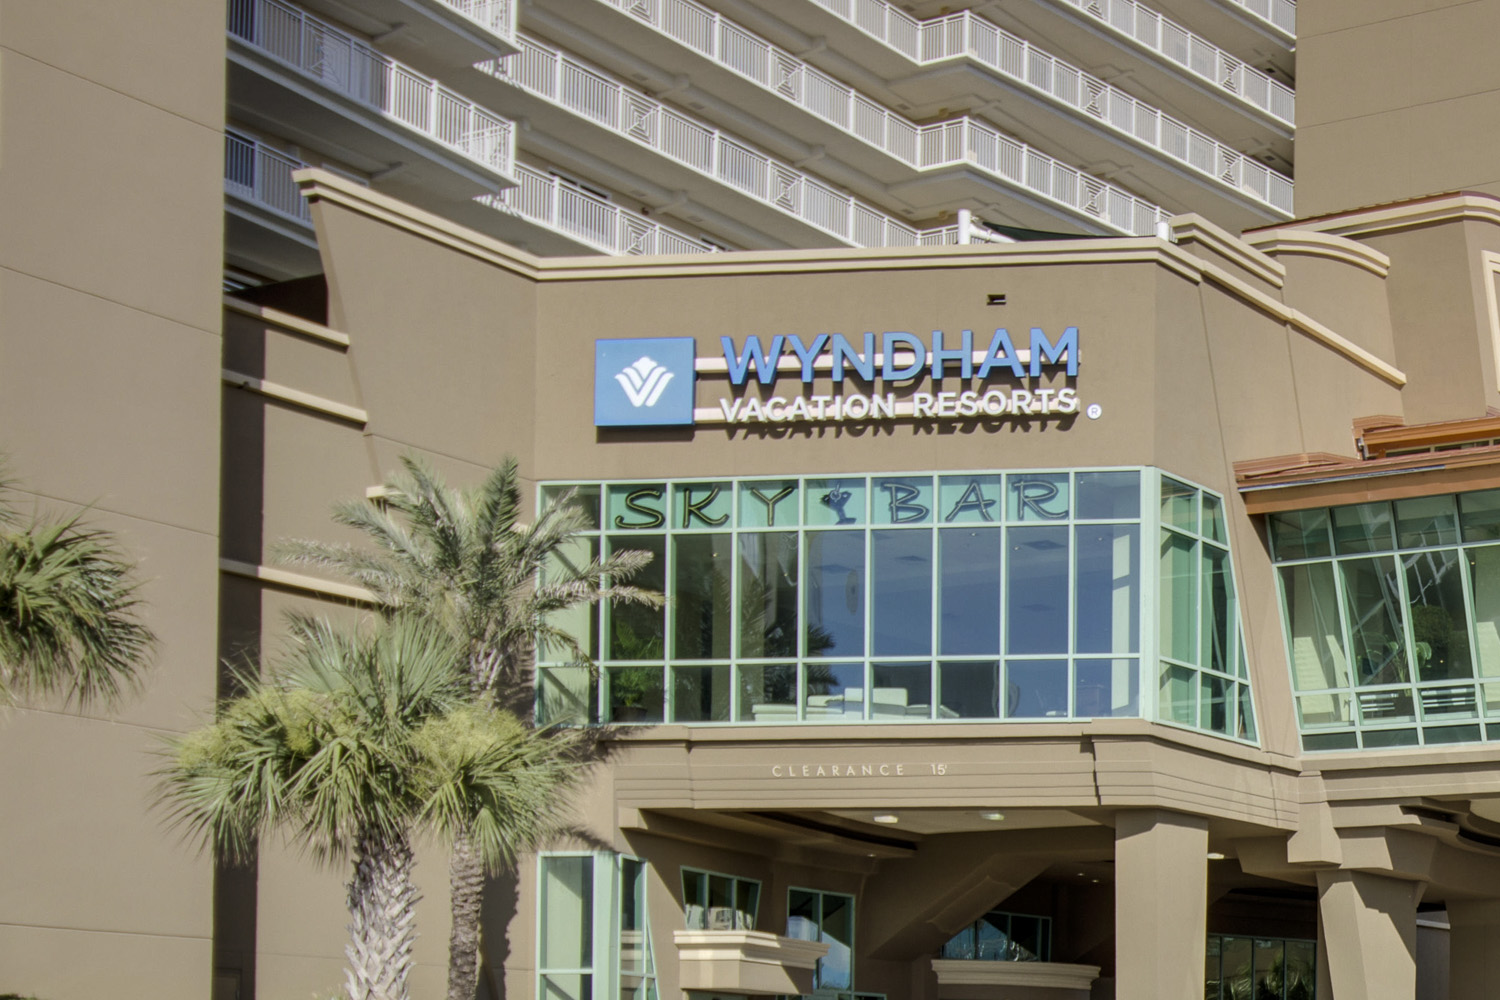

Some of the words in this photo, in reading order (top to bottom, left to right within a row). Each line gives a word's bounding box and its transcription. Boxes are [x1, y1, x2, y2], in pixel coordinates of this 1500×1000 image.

[720, 326, 1079, 385] WYNDHAM
[720, 392, 896, 424] VACATION
[912, 387, 1078, 419] RESORTS
[614, 484, 796, 530] SKY
[880, 481, 1070, 525] BAR
[772, 764, 904, 777] CLEARANCE
[930, 763, 947, 776] 15'
